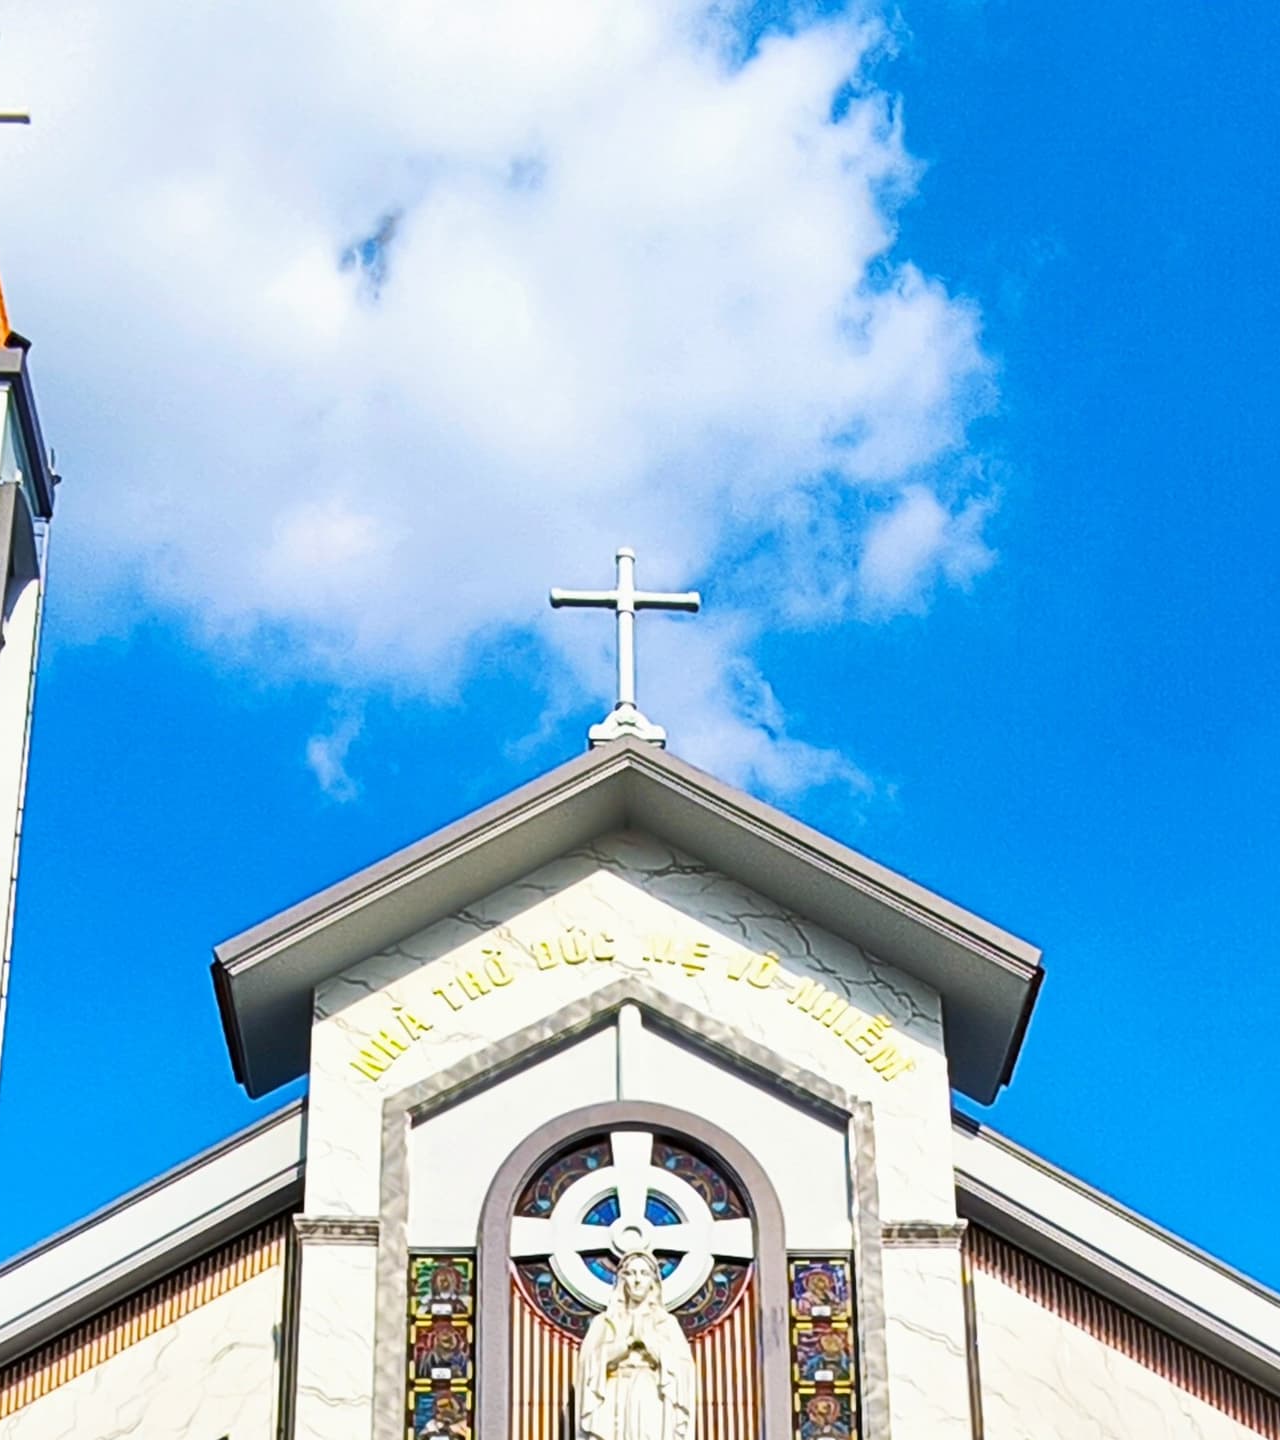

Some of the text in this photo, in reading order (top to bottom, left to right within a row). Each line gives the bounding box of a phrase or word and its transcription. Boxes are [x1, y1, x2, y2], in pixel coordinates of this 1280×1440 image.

[349, 1006, 433, 1083] NHÀ
[432, 949, 515, 1012] THỜ
[642, 932, 712, 977] MẸ
[726, 950, 780, 989] VÔ
